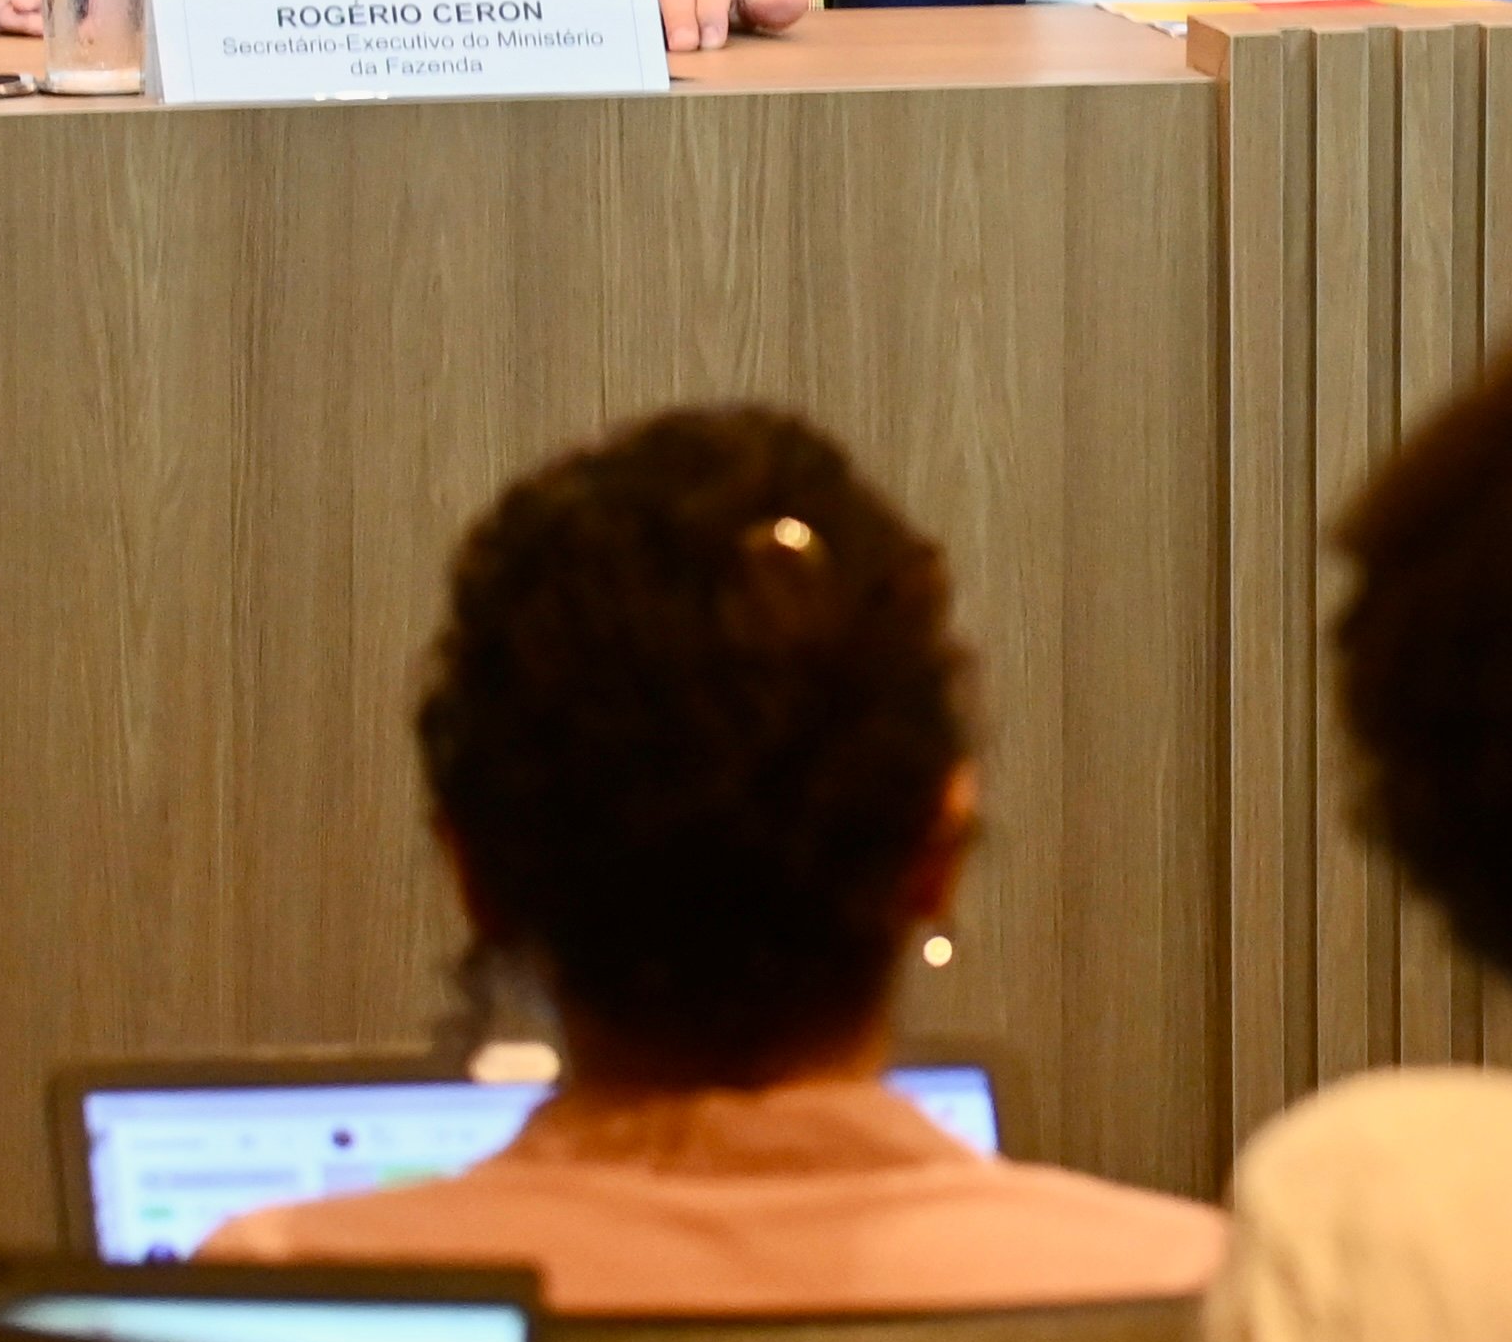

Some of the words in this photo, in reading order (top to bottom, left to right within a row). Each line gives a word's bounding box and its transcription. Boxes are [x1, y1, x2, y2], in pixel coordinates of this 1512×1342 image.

[276, 0, 423, 28] ROGÉRIO
[432, 1, 543, 24] CERON
[222, 33, 455, 56] Secretário-Executivo
[461, 31, 490, 49] do
[496, 29, 604, 48] Ministério
[350, 59, 378, 76] da
[385, 56, 484, 75] Fazenda
